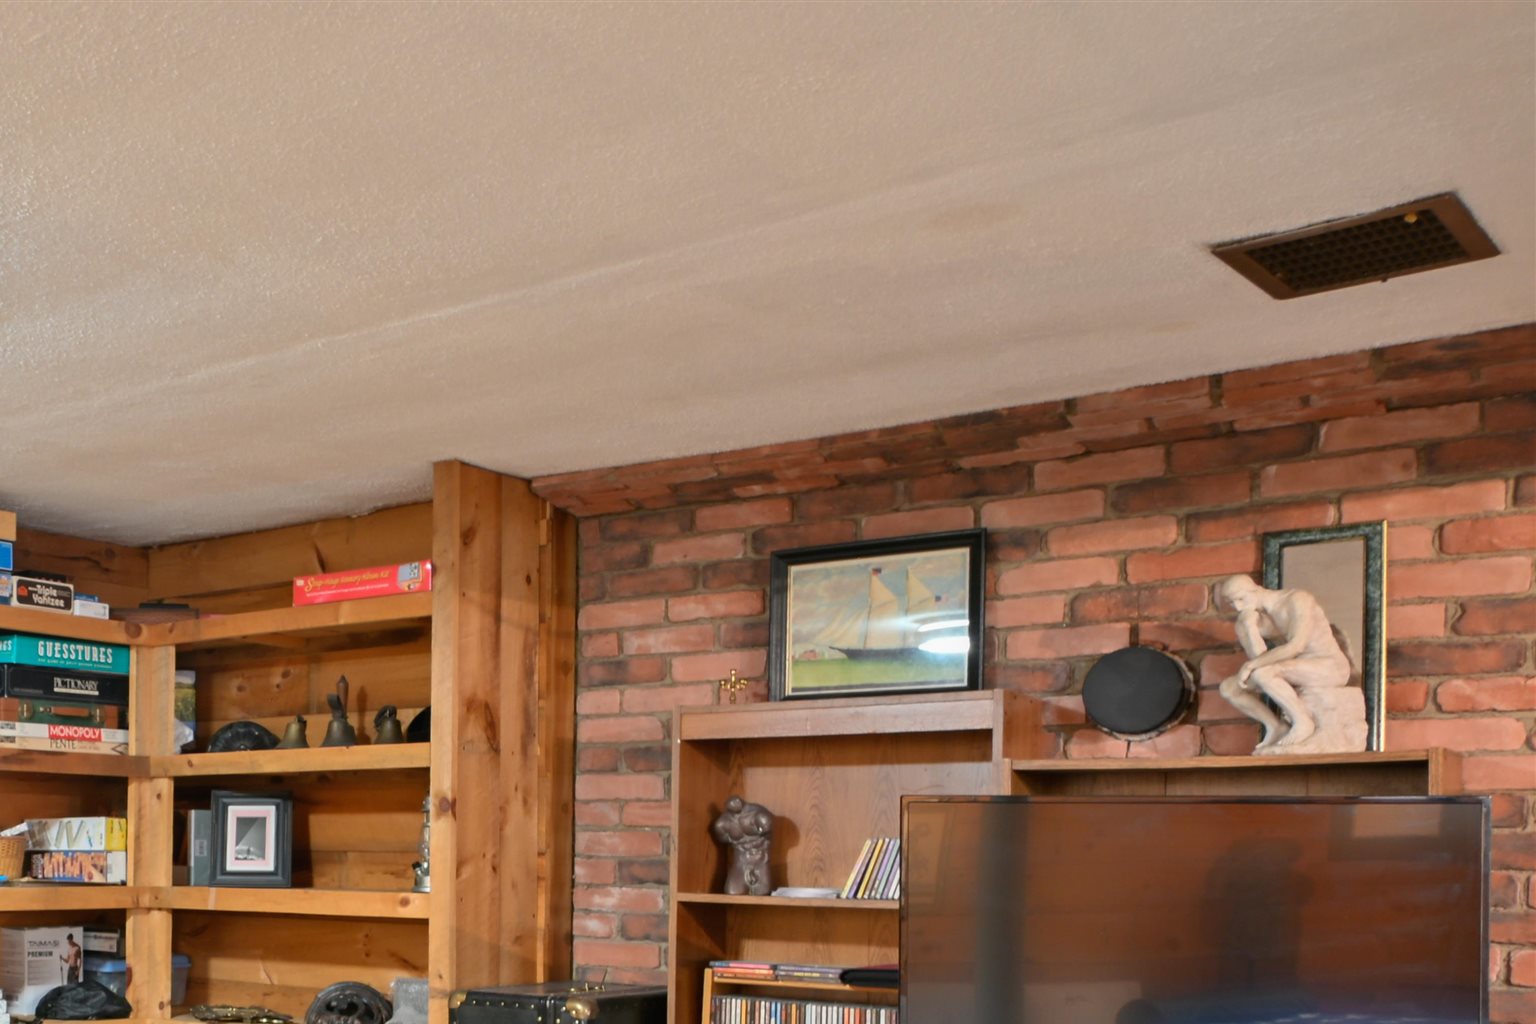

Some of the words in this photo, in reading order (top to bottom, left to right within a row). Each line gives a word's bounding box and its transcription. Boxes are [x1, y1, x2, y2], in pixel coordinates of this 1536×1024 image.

[36, 584, 58, 597] Triple
[32, 593, 65, 607] Yahtzee
[38, 641, 113, 663] GUESSTURES
[53, 677, 99, 690] PICTIONARY
[50, 726, 100, 740] MONOPOLY
[49, 739, 76, 750] PENTE
